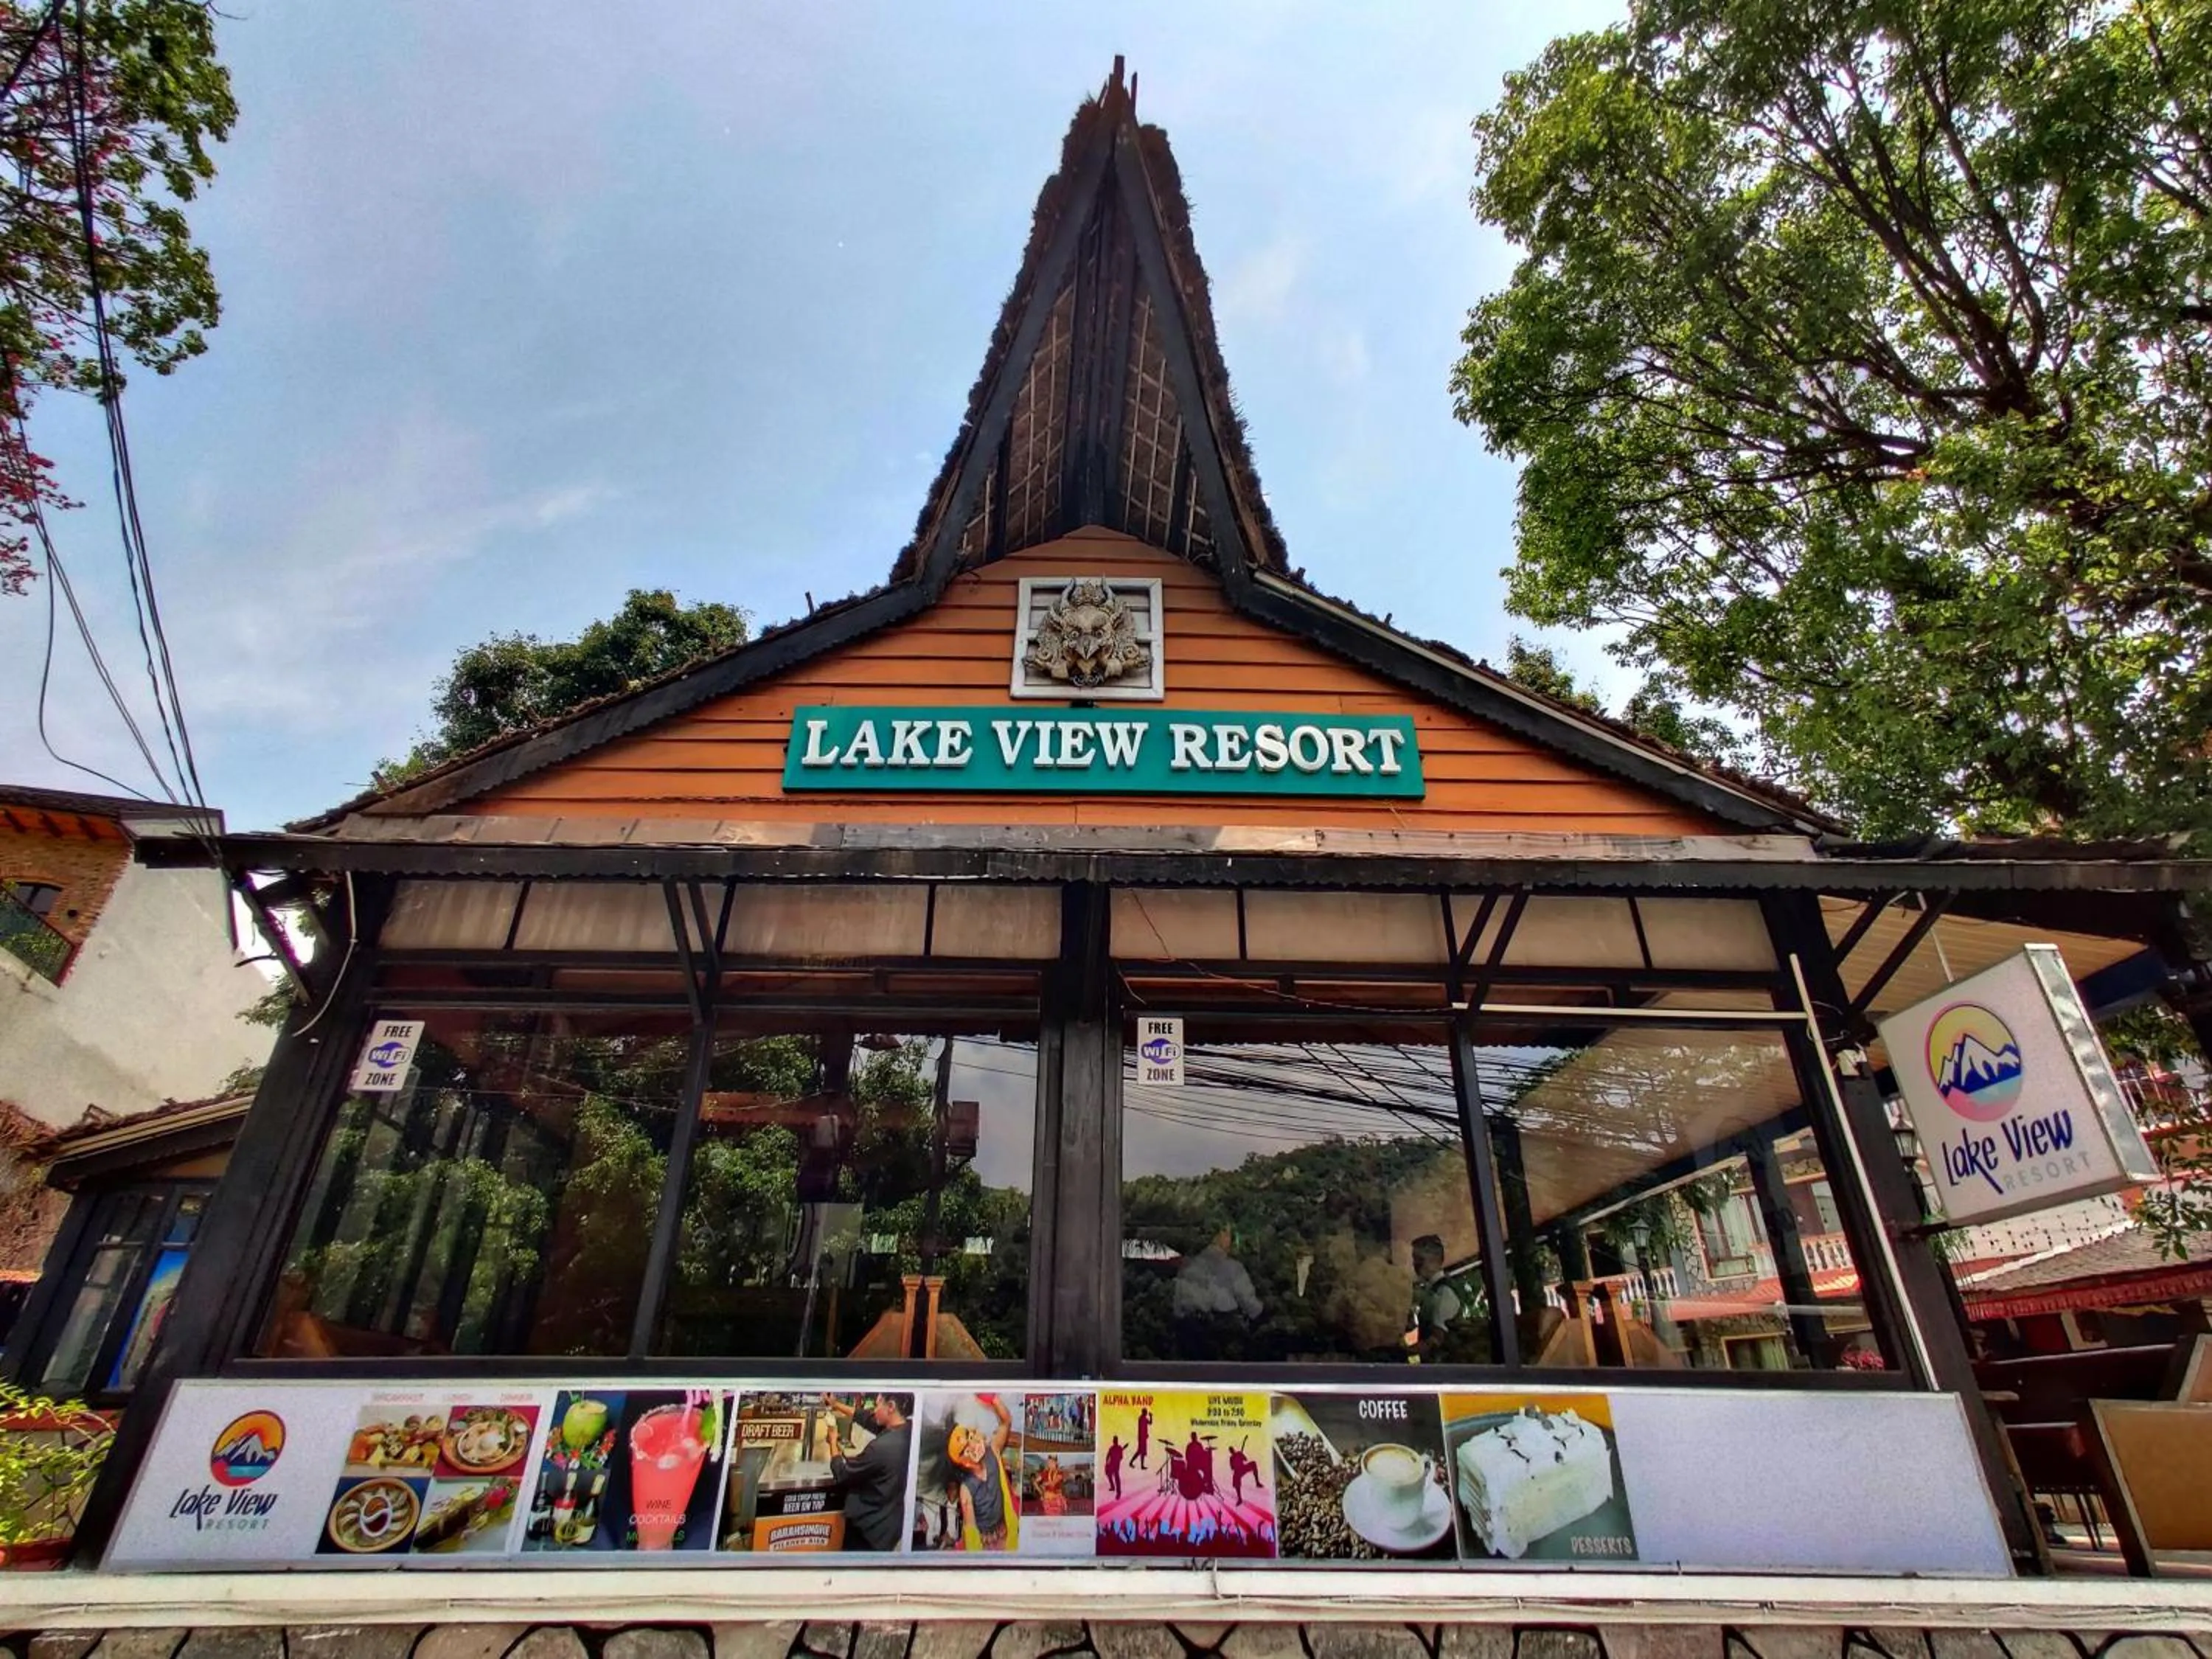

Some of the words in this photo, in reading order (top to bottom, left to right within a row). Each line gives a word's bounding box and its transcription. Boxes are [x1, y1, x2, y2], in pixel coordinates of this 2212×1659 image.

[801, 719, 973, 768] LAKE
[991, 720, 1149, 769] VIEW
[1169, 723, 1405, 776] RESORT
[383, 1026, 413, 1038] FREE
[1148, 1022, 1174, 1034] FREE
[364, 1073, 397, 1086] ZONE
[1147, 1068, 1175, 1082] ZONE
[1941, 1127, 2004, 1194] Lake
[2000, 1109, 2073, 1163] View
[2003, 1151, 2091, 1191] RESORT
[1359, 1399, 1408, 1419] COFFEE
[741, 1424, 771, 1439] DRAFT
[771, 1424, 794, 1438] BEER
[169, 1484, 222, 1531] Lake
[225, 1489, 279, 1515] View
[646, 1499, 672, 1509] WINE
[205, 1519, 270, 1530] RESORT
[629, 1513, 686, 1526] COCKTAILS
[1570, 1536, 1632, 1554] DESSERTS
